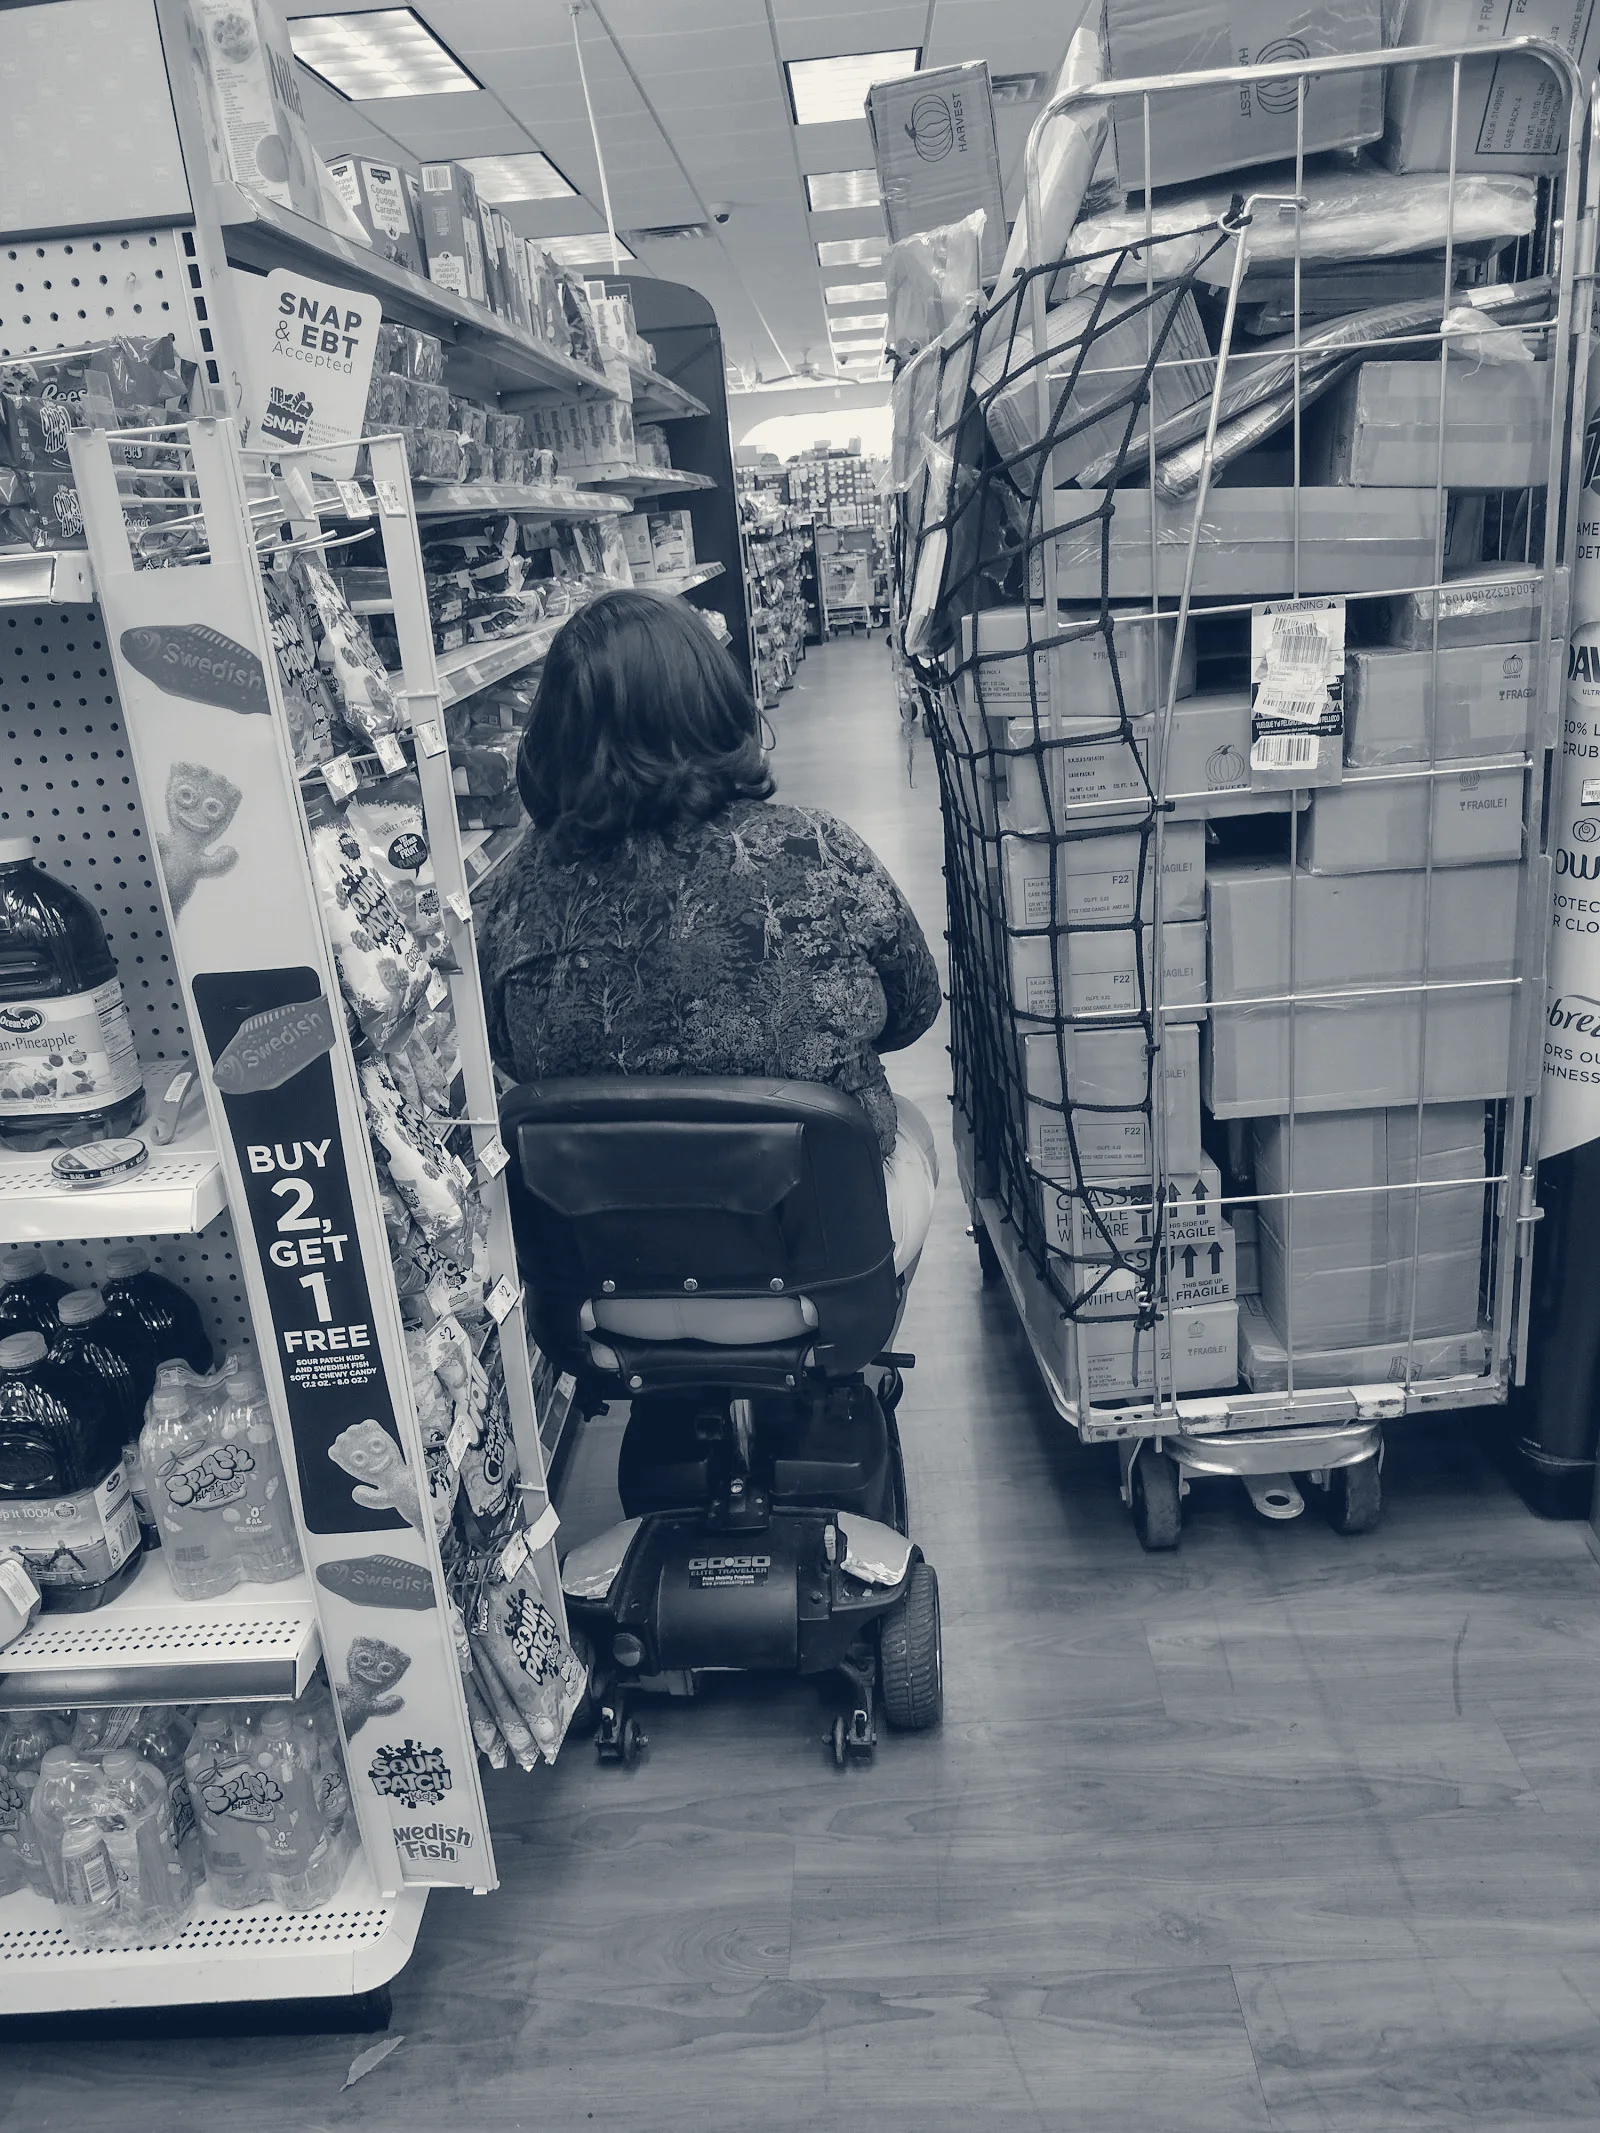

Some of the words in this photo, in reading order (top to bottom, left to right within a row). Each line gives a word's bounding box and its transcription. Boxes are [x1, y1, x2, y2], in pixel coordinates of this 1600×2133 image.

[1238, 48, 1251, 118] HAVEST
[952, 92, 968, 153] HARVEST
[370, 184, 399, 198] Coconut
[376, 195, 397, 208] Fudge
[374, 204, 402, 217] Caramel
[278, 291, 363, 333] SNAP
[275, 320, 290, 342] &
[301, 324, 359, 359] EBT
[272, 341, 353, 375] Accepted
[263, 412, 306, 436] SNAP
[1277, 600, 1323, 612] WARNING
[163, 642, 262, 692] Swedish
[1467, 798, 1507, 810] FRAGILE!
[399, 843, 419, 859] FRUIT
[1112, 875, 1129, 884] F22
[1114, 975, 1129, 984] F22
[21, 1014, 41, 1030] Spray
[242, 1012, 324, 1068] Swedish
[1125, 1127, 1141, 1135] F22
[246, 1138, 332, 1174] BUY
[100, 1169, 113, 1177] SHOE
[114, 1164, 127, 1173] GEAR
[270, 1177, 333, 1233] 2,
[1095, 1223, 1129, 1238] CARE
[269, 1234, 349, 1268] GET
[298, 1271, 333, 1323] 1
[499, 1285, 511, 1299] $2
[1176, 1284, 1230, 1301] FRAGILE
[283, 1324, 371, 1353] FREE
[440, 1325, 456, 1342] $2
[1193, 1346, 1227, 1355] FRAGILE!
[296, 1358, 318, 1366] SOUR
[320, 1356, 344, 1364] PATCH
[345, 1353, 365, 1361] KIDS
[314, 1363, 350, 1372] SWEDISH
[351, 1361, 369, 1369] FISH
[319, 1371, 348, 1379] CHEWY
[349, 1368, 377, 1376] CANDY
[351, 1376, 368, 1384] OZ.)
[165, 1444, 255, 1507] SPLASH
[209, 1473, 245, 1502] LEMON
[12, 1508, 20, 1518] it
[22, 1507, 55, 1518] 100%
[250, 1506, 260, 1518] 0
[246, 1517, 263, 1525] CAL
[718, 1567, 767, 1575] TRAVELLER
[351, 1569, 434, 1593] Swedish
[512, 1597, 540, 1663] SOUR
[525, 1608, 557, 1685] PATCH
[371, 1754, 444, 1776] SOUR
[372, 1772, 452, 1796] PATCH
[409, 1790, 438, 1801] Kids
[275, 1839, 289, 1848] CAL
[279, 1831, 286, 1841] 0
[393, 1823, 472, 1848] wedish
[401, 1840, 456, 1861] Fish
